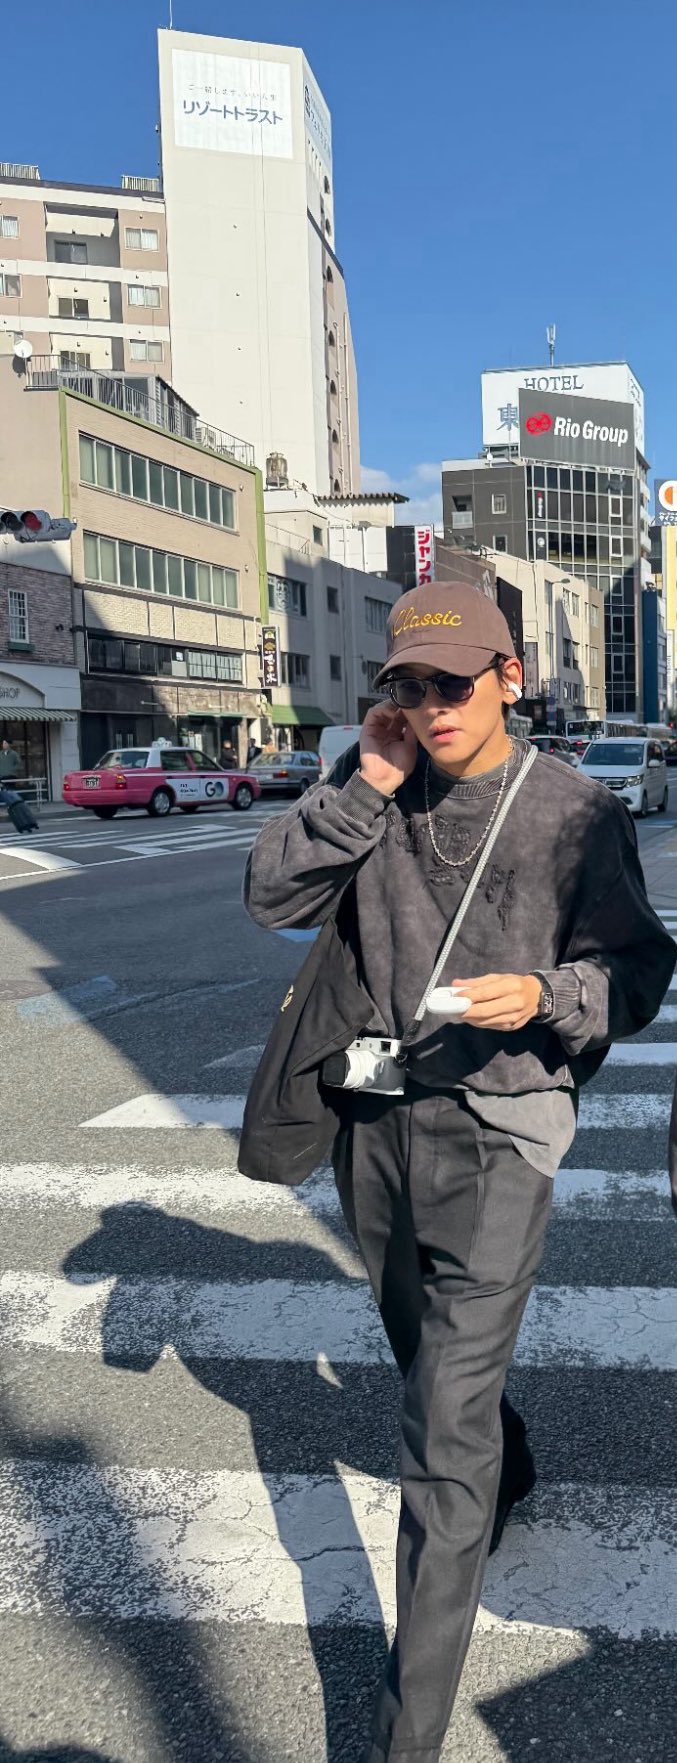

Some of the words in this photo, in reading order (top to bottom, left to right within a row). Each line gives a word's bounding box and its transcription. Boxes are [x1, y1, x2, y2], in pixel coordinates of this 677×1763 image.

[183, 99, 283, 125] リゾートトラスト
[524, 374, 584, 391] HOTEL
[553, 416, 581, 438] Rio
[582, 420, 628, 447] Group
[392, 606, 462, 639] Classic
[205, 781, 225, 798] GO
